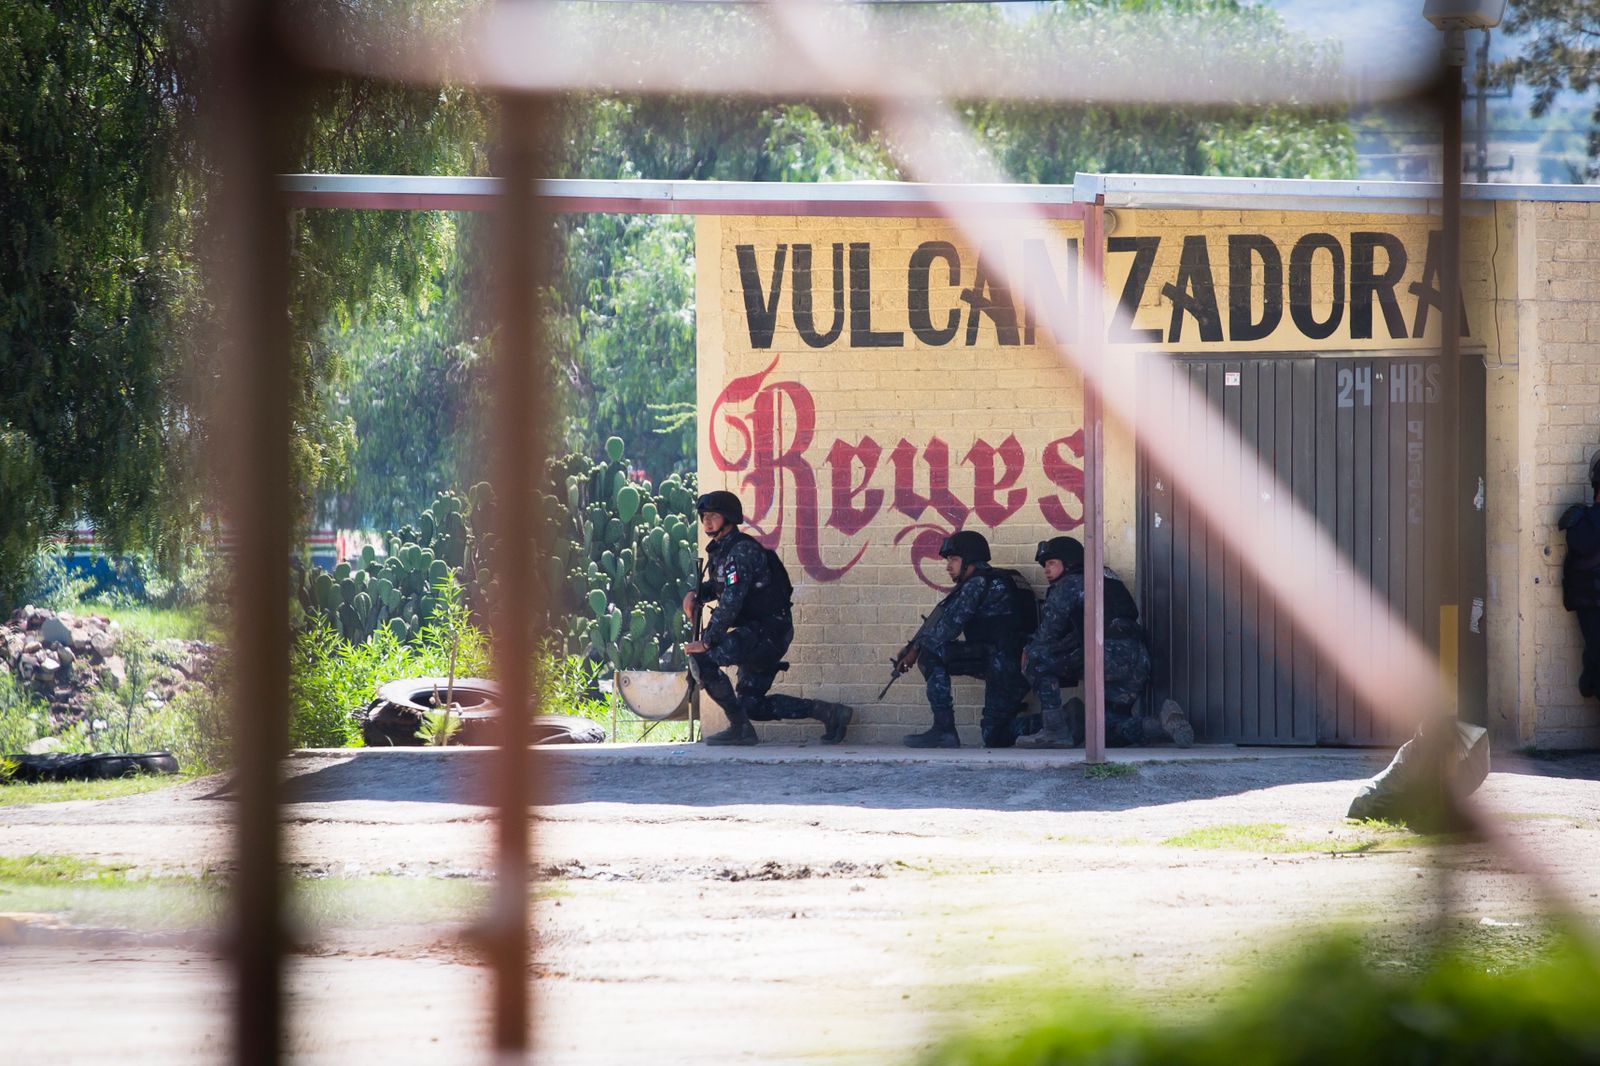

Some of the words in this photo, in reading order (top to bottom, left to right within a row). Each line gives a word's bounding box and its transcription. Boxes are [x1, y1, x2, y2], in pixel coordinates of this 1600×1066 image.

[735, 231, 1471, 349] VULCANZADORA
[1337, 366, 1372, 409] 24
[1390, 362, 1441, 404] HRS
[708, 353, 1085, 593] Reyes
